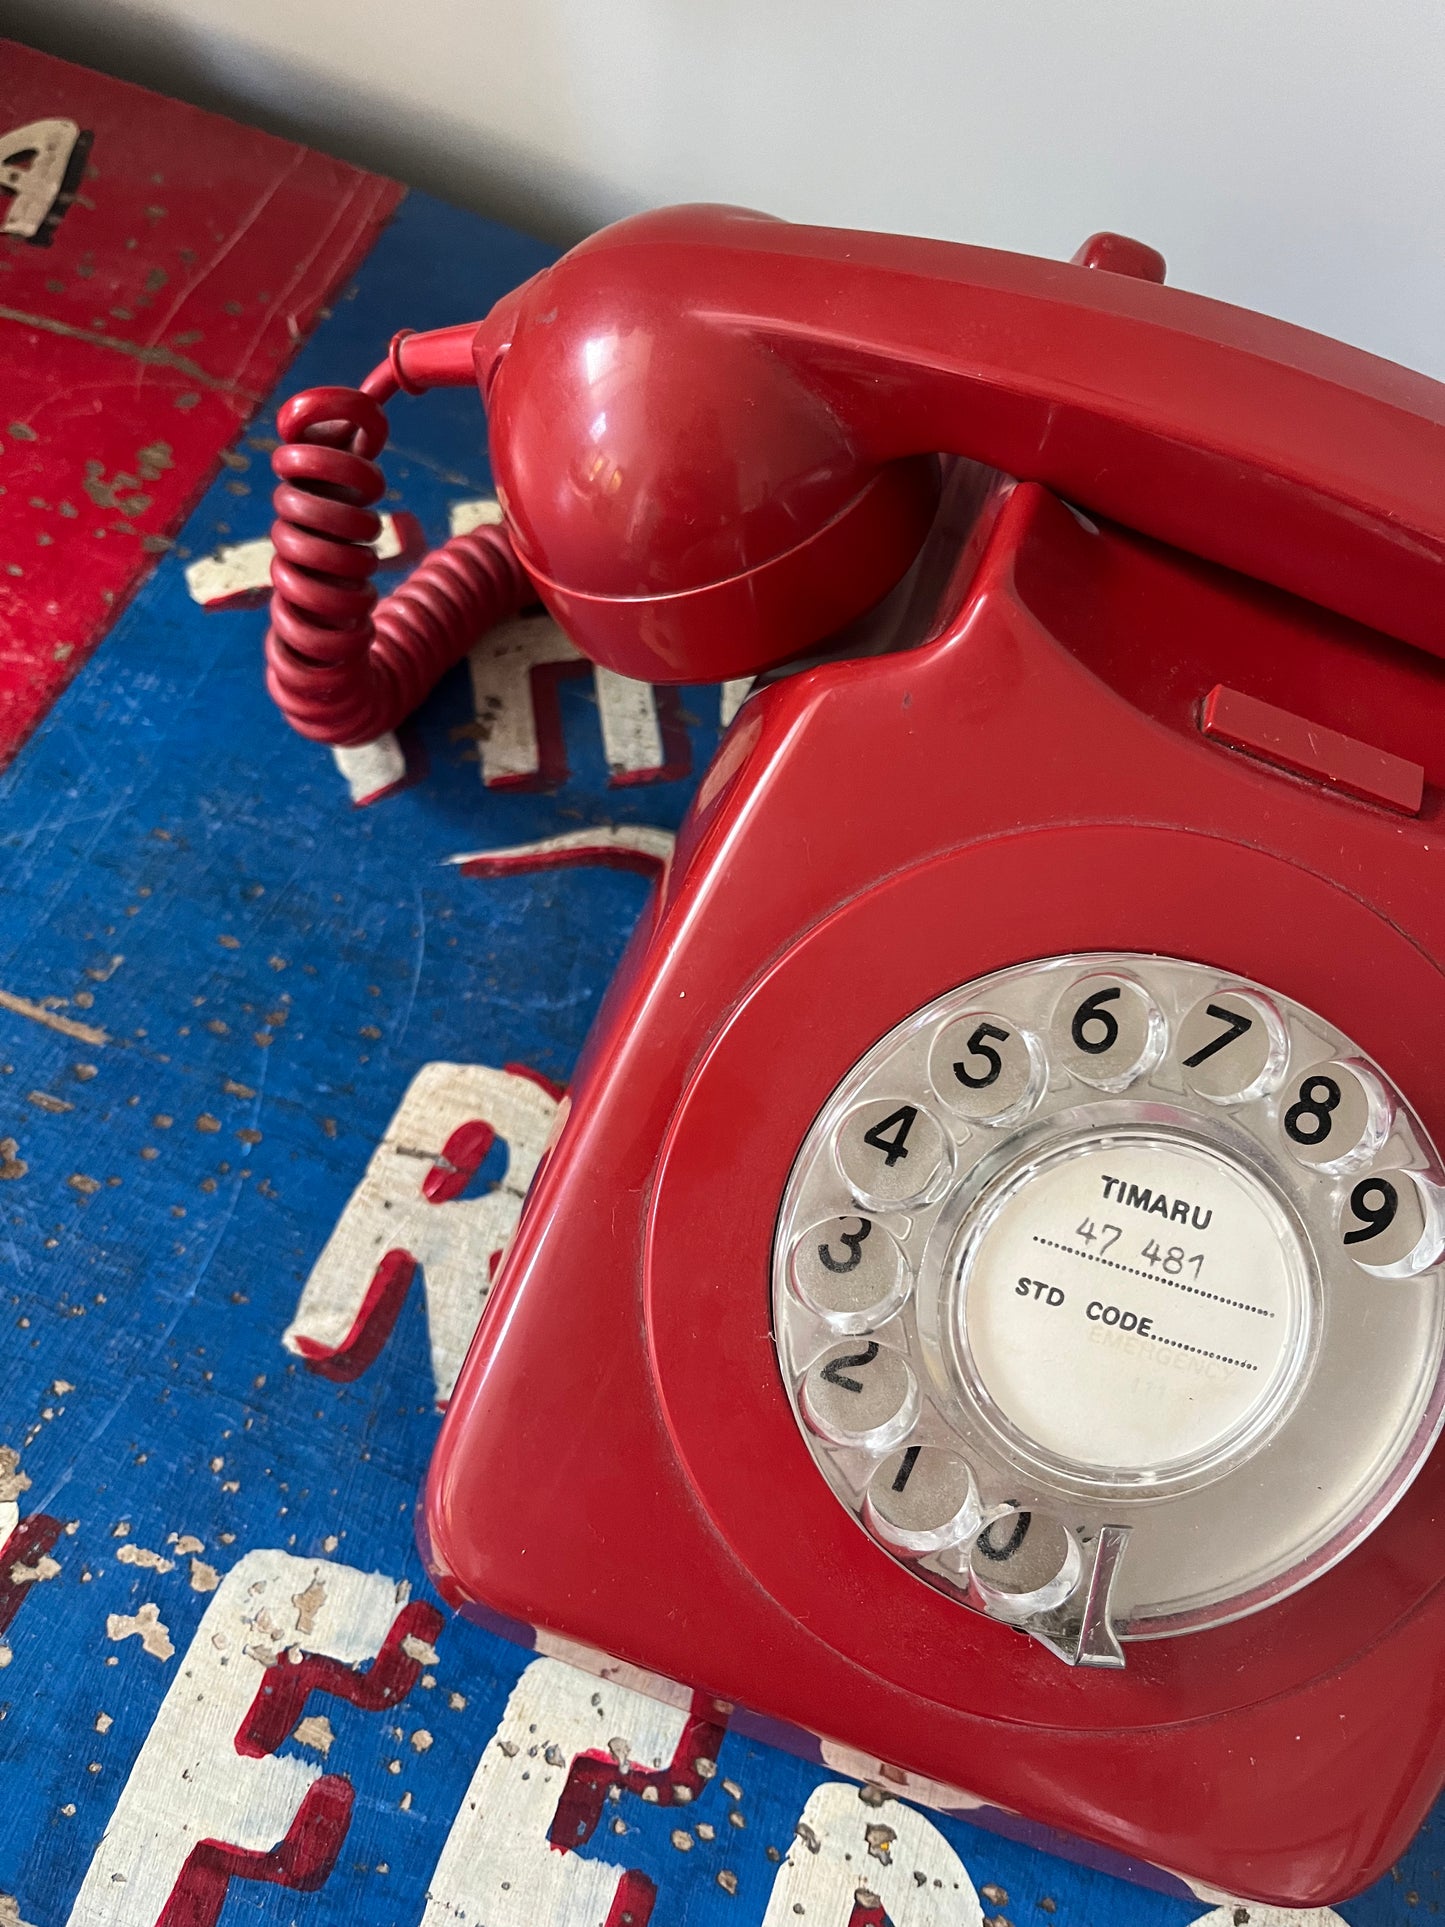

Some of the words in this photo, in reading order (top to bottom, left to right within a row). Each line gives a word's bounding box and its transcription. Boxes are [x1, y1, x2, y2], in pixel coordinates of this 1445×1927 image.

[1071, 987, 1120, 1055] 6
[1182, 1003, 1253, 1068] 7
[952, 1022, 1010, 1089] 5
[863, 1105, 918, 1168] 4
[1284, 1075, 1341, 1146] 8
[1101, 1174, 1213, 1230] TIMARU
[1343, 1177, 1399, 1245] 9
[818, 1214, 873, 1274] 3
[1075, 1216, 1123, 1257] 47
[1140, 1238, 1205, 1281] 481
[1014, 1276, 1065, 1307] STD
[820, 1340, 880, 1394] 2
[891, 1445, 922, 1493] 1
